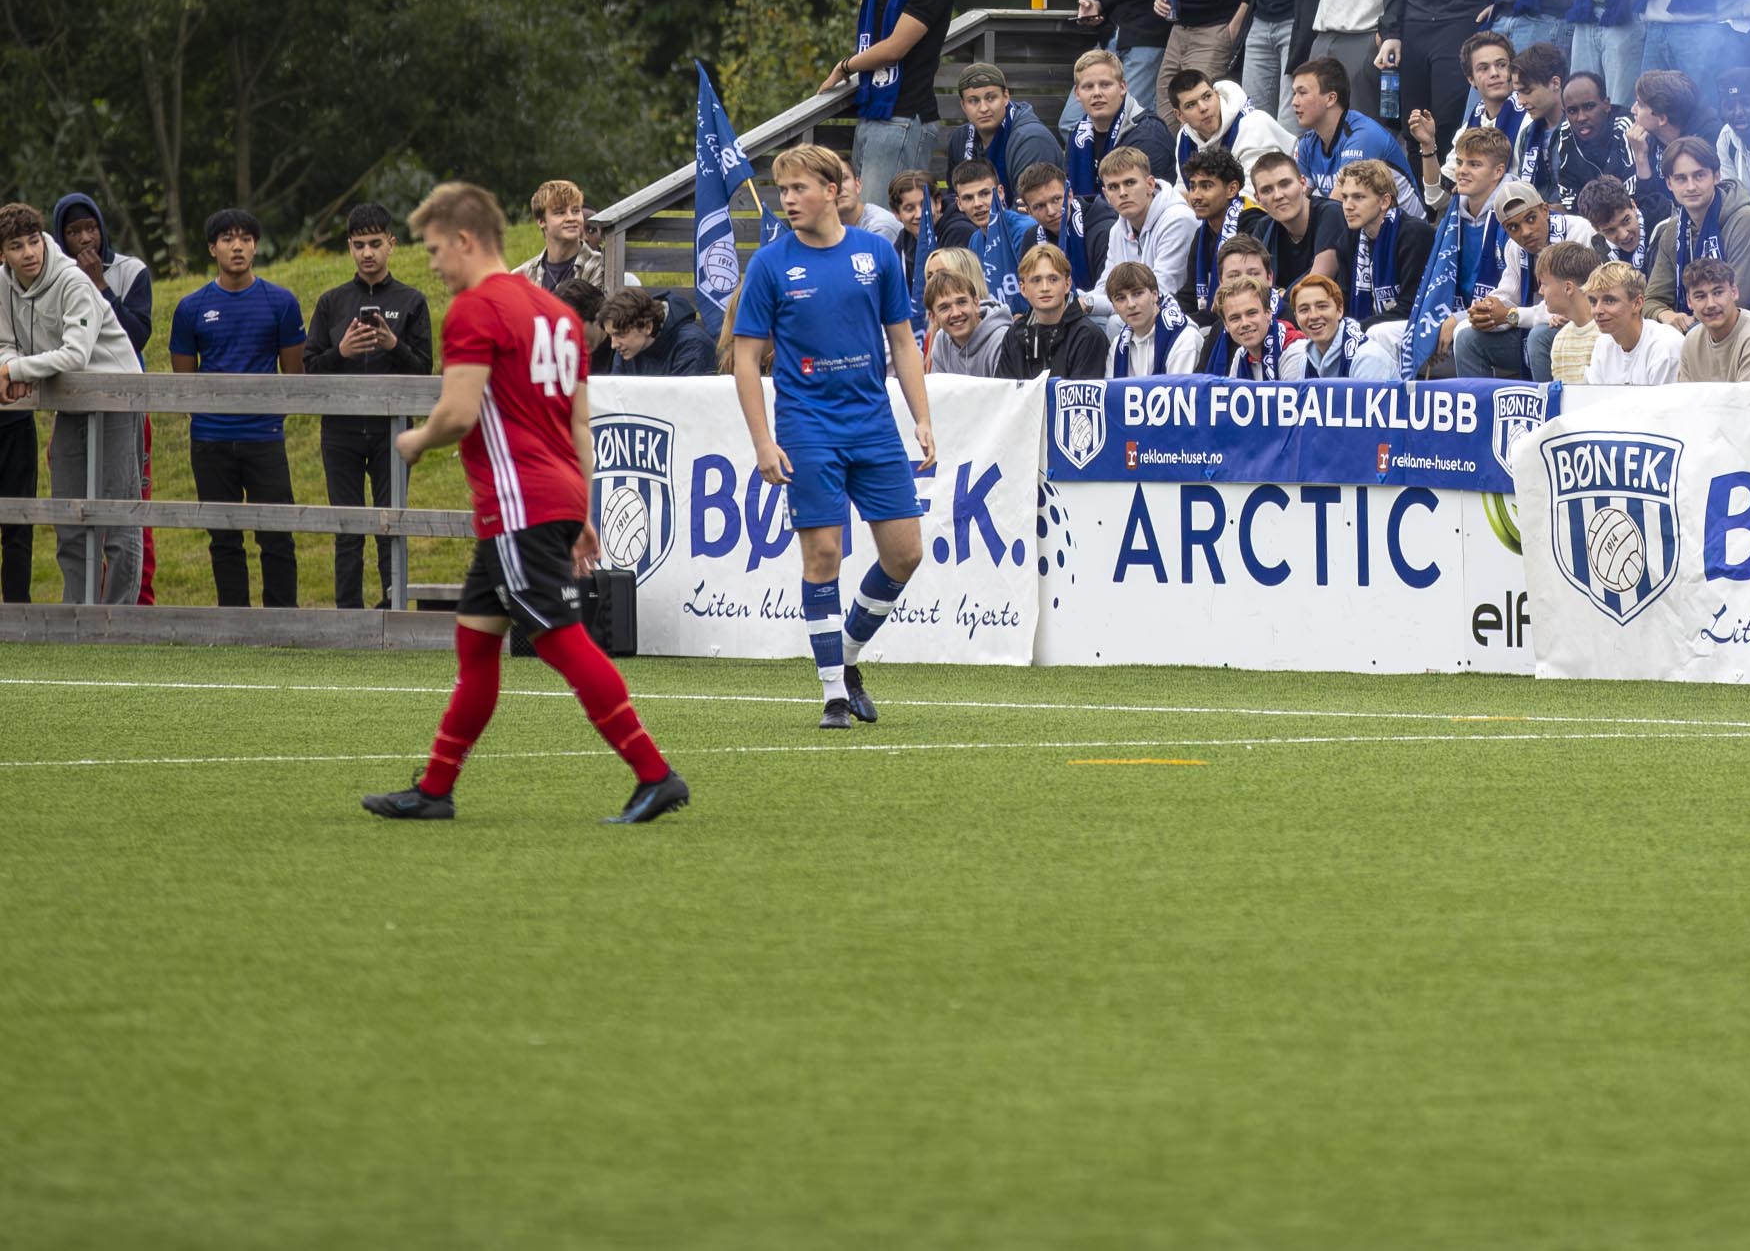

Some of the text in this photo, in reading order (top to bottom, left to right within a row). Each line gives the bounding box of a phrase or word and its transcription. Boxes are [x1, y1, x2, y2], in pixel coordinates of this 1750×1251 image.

[718, 255, 734, 269] 1914
[385, 310, 400, 319] EA7
[530, 315, 580, 397] 46
[1060, 386, 1084, 407] BØN
[1499, 395, 1525, 417] BØN
[1123, 385, 1478, 434] BØN FOTBALLKLUBB
[634, 428, 666, 474] F.K.
[1139, 448, 1223, 465] reklame-huset.no
[1391, 452, 1477, 473] reklame-huset.no
[1556, 442, 1669, 493] BØN F.K.
[616, 510, 630, 534] 1914
[690, 453, 853, 574] BØ
[1112, 482, 1441, 590] ARCTIC
[1604, 532, 1620, 557] 1914
[683, 579, 751, 618] Liten
[955, 593, 1021, 640] hjerte
